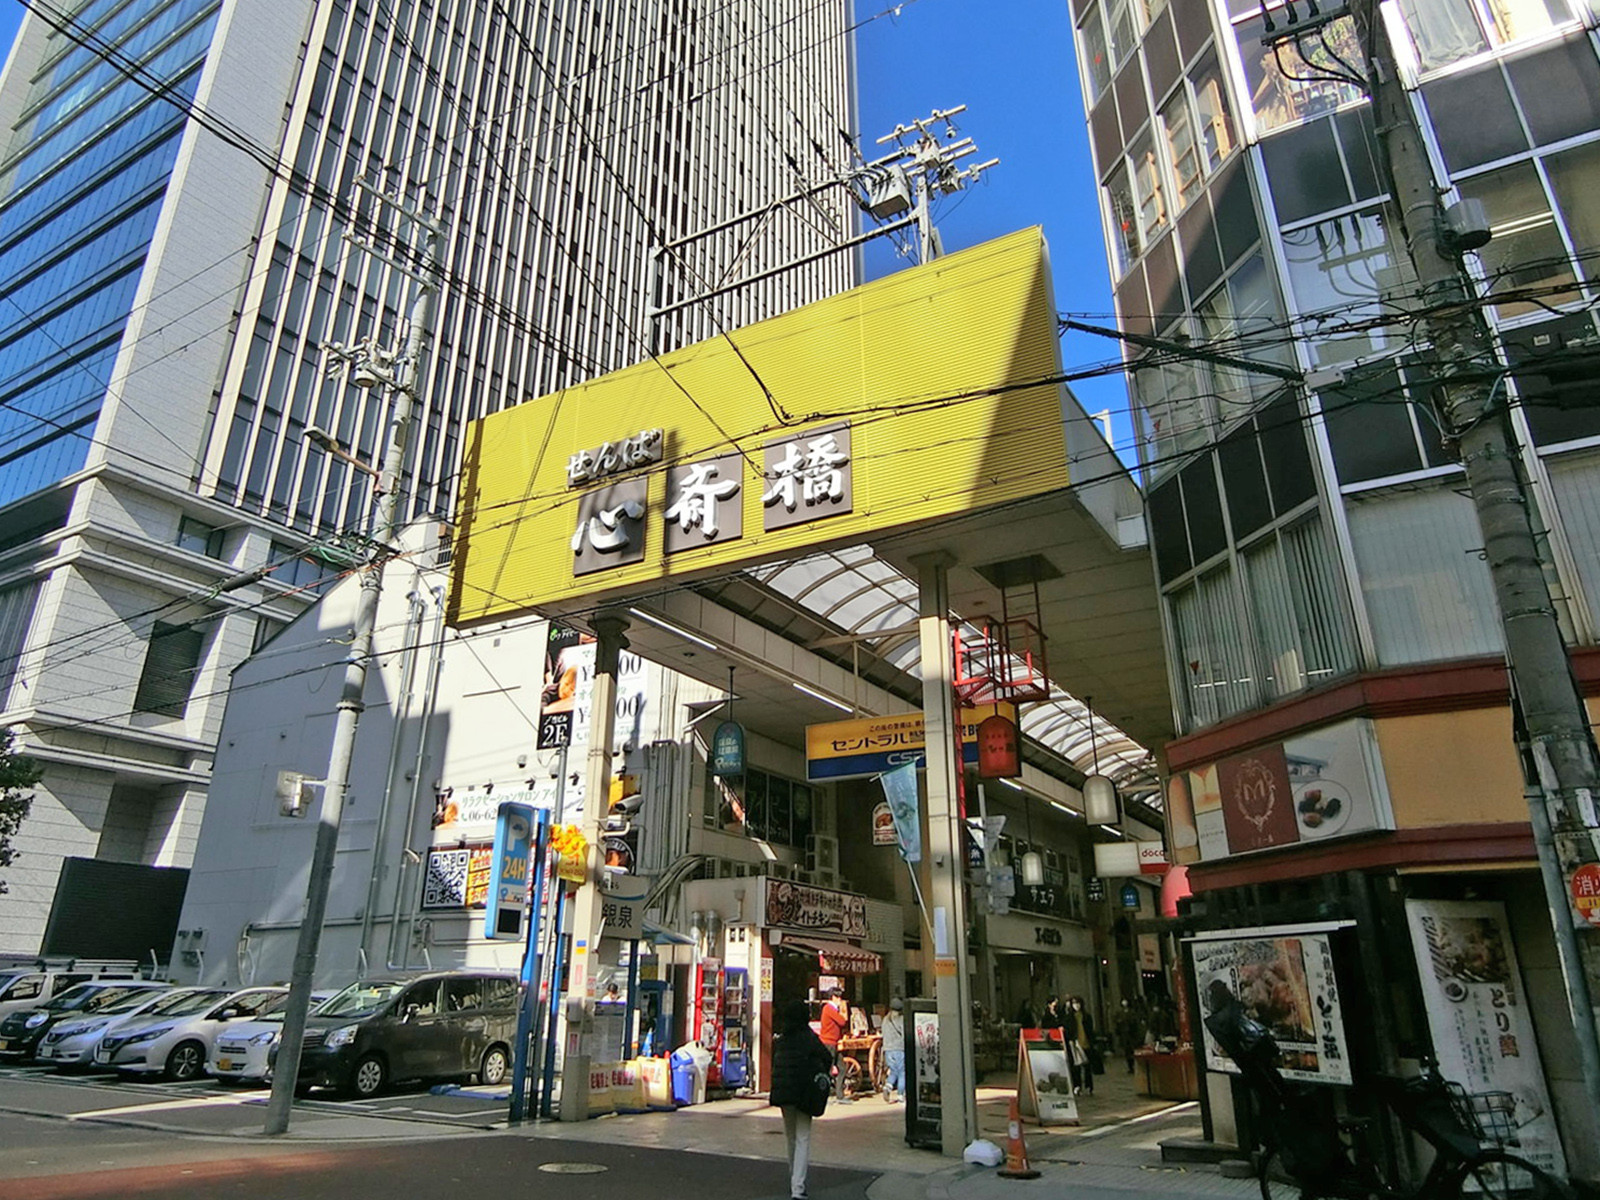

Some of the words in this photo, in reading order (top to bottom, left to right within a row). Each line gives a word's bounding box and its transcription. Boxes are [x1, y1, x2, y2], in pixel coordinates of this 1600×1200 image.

[565, 430, 661, 479] せんば
[542, 723, 568, 747] 2F
[502, 856, 526, 880] 24H
[602, 903, 633, 929] 銀泉
